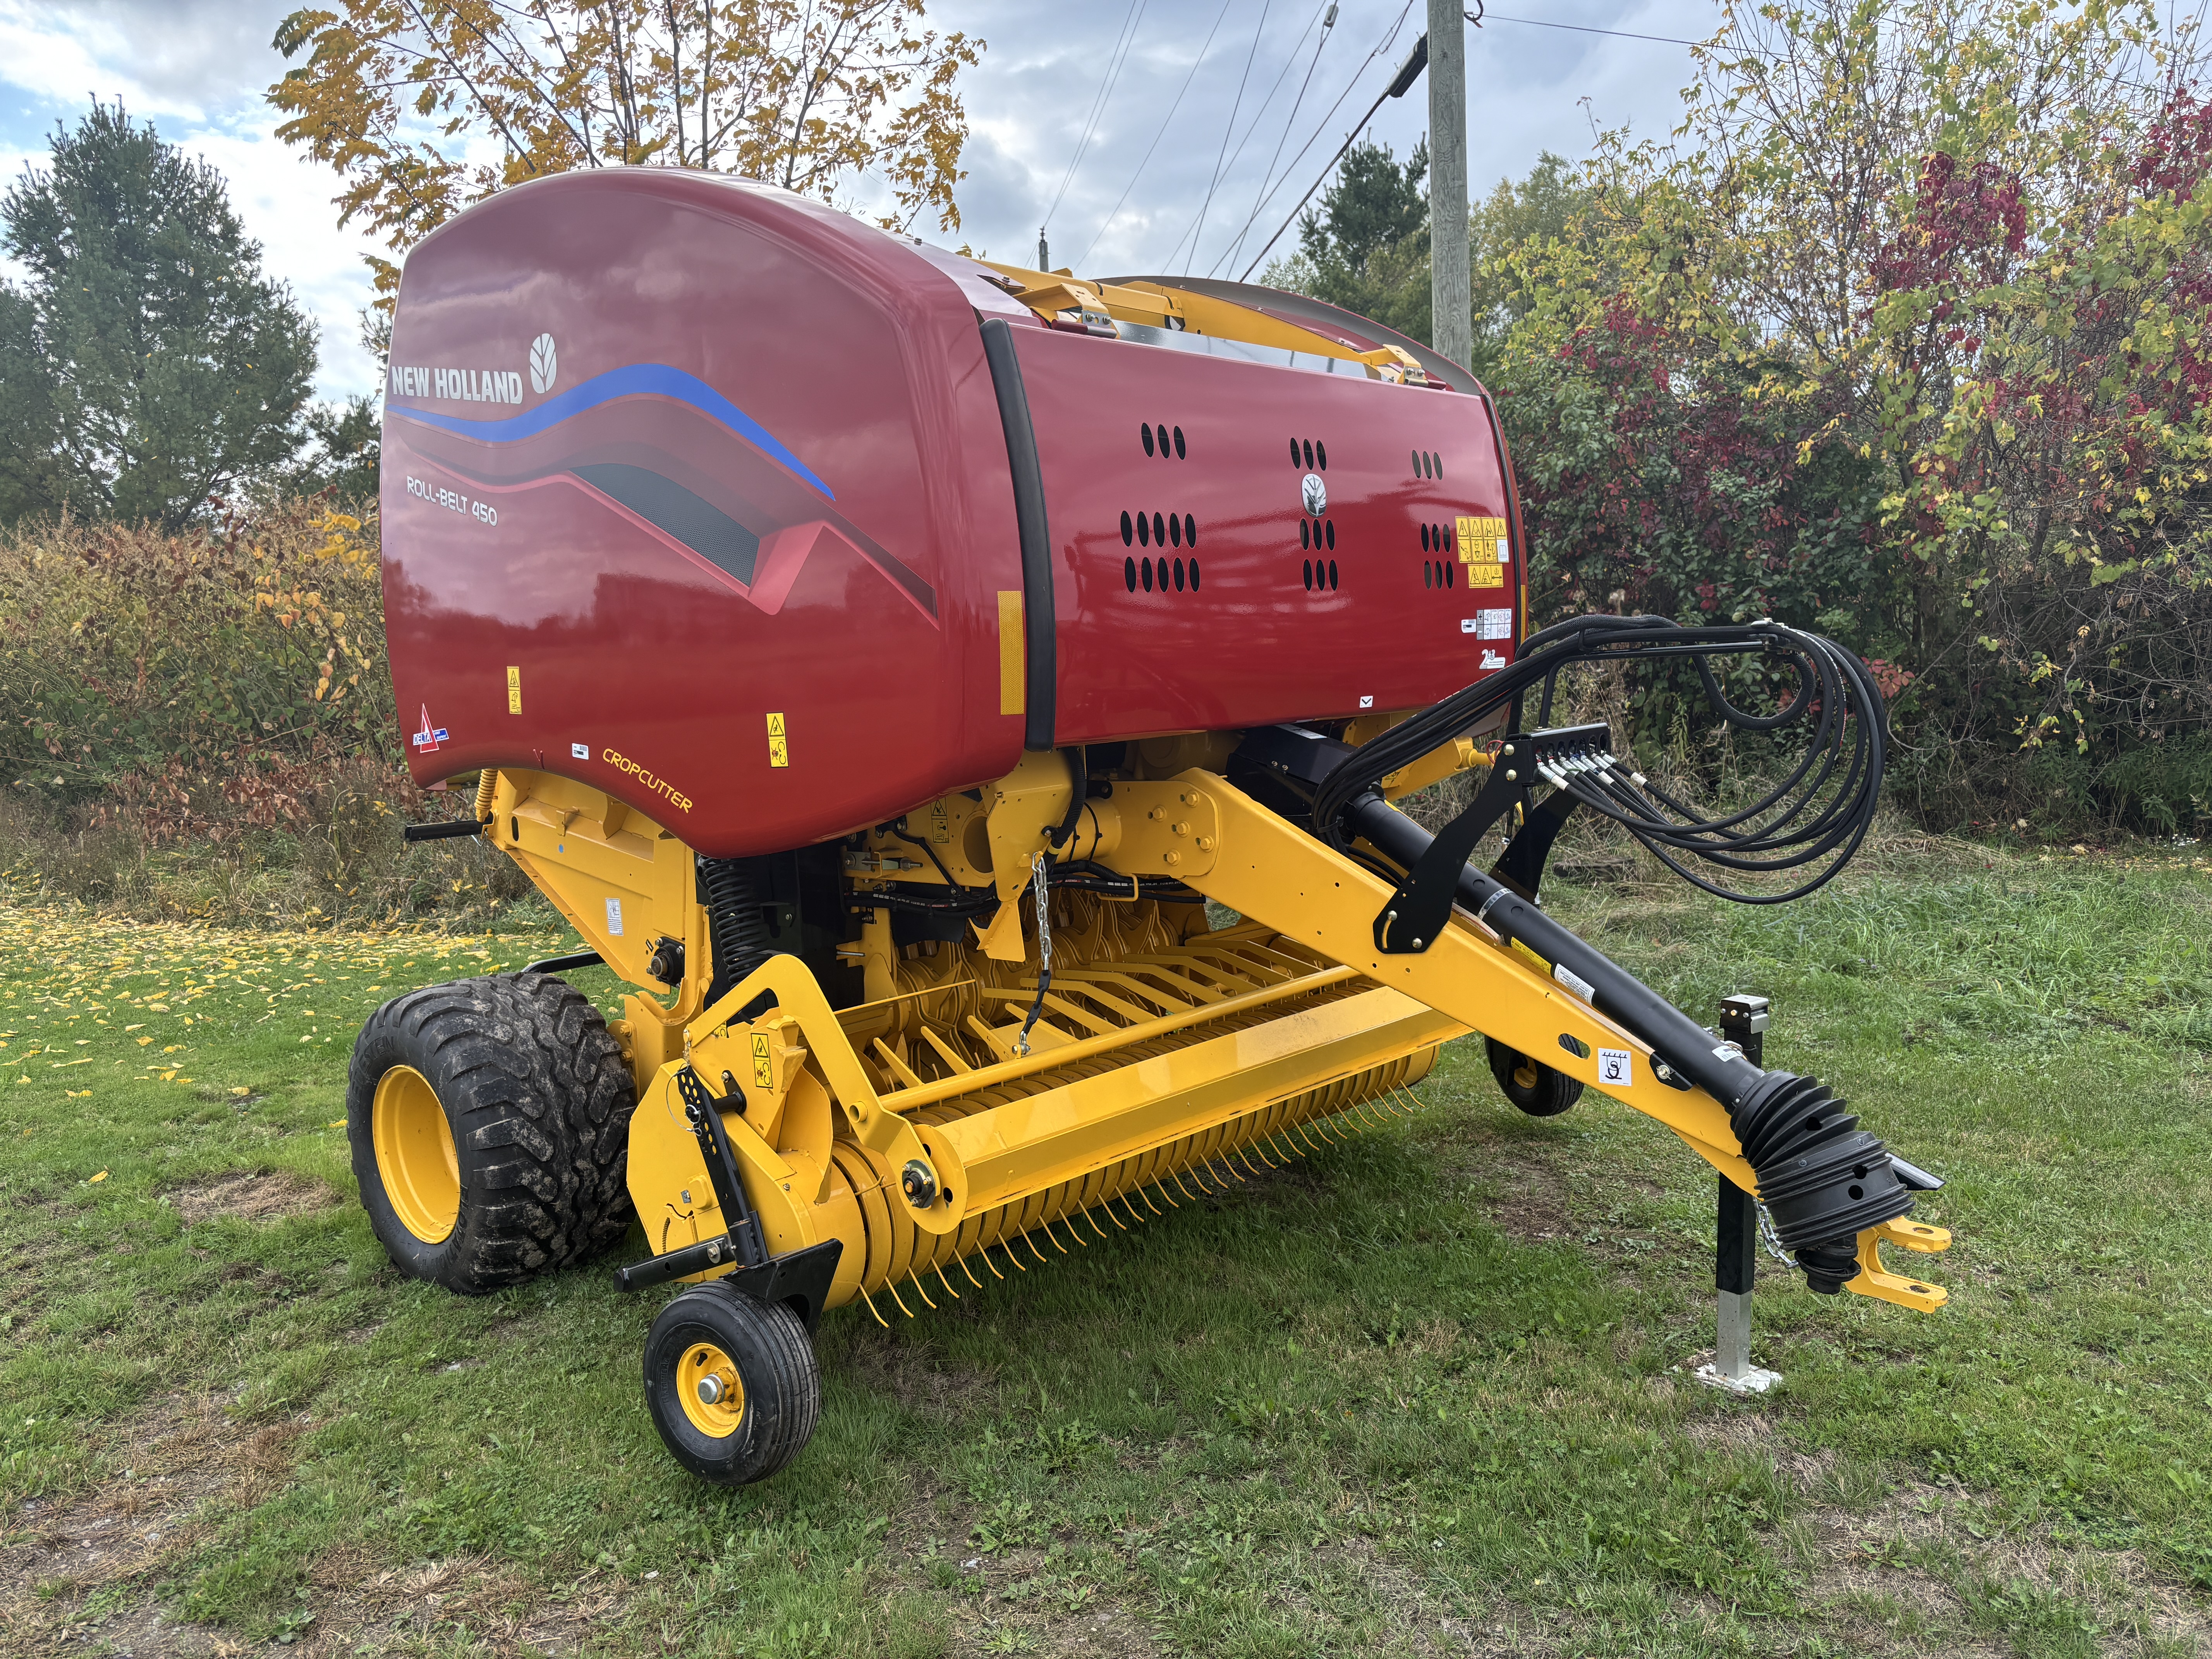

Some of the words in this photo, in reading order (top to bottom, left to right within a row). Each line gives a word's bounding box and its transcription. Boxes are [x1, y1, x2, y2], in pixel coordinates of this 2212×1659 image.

[392, 366, 429, 397] NEW
[434, 368, 523, 404] HOLLAND
[406, 476, 468, 515] ROLL-BELT
[471, 500, 498, 527] 450
[414, 732, 431, 744] DELTA
[602, 748, 693, 814] CROPCUTTER
